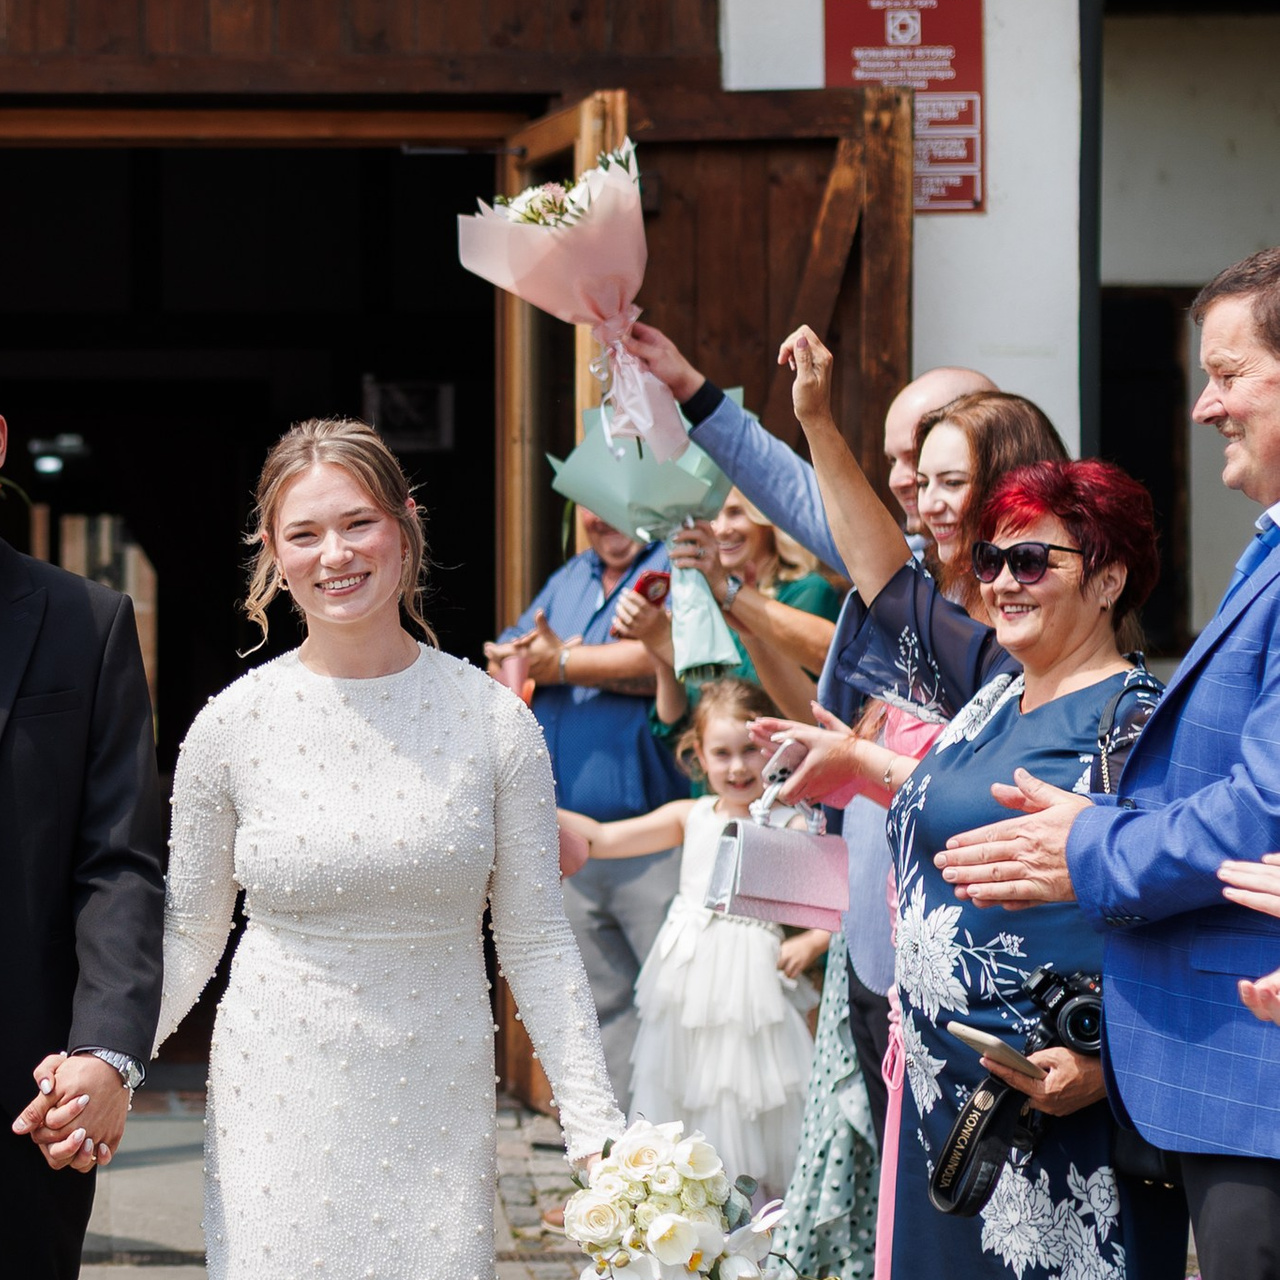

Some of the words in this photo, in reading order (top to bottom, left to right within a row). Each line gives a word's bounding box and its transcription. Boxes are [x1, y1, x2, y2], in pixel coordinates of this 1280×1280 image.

[1048, 989, 1065, 1008] SONY
[955, 1109, 982, 1150] KONICA
[939, 1149, 963, 1188] MINOLTA
